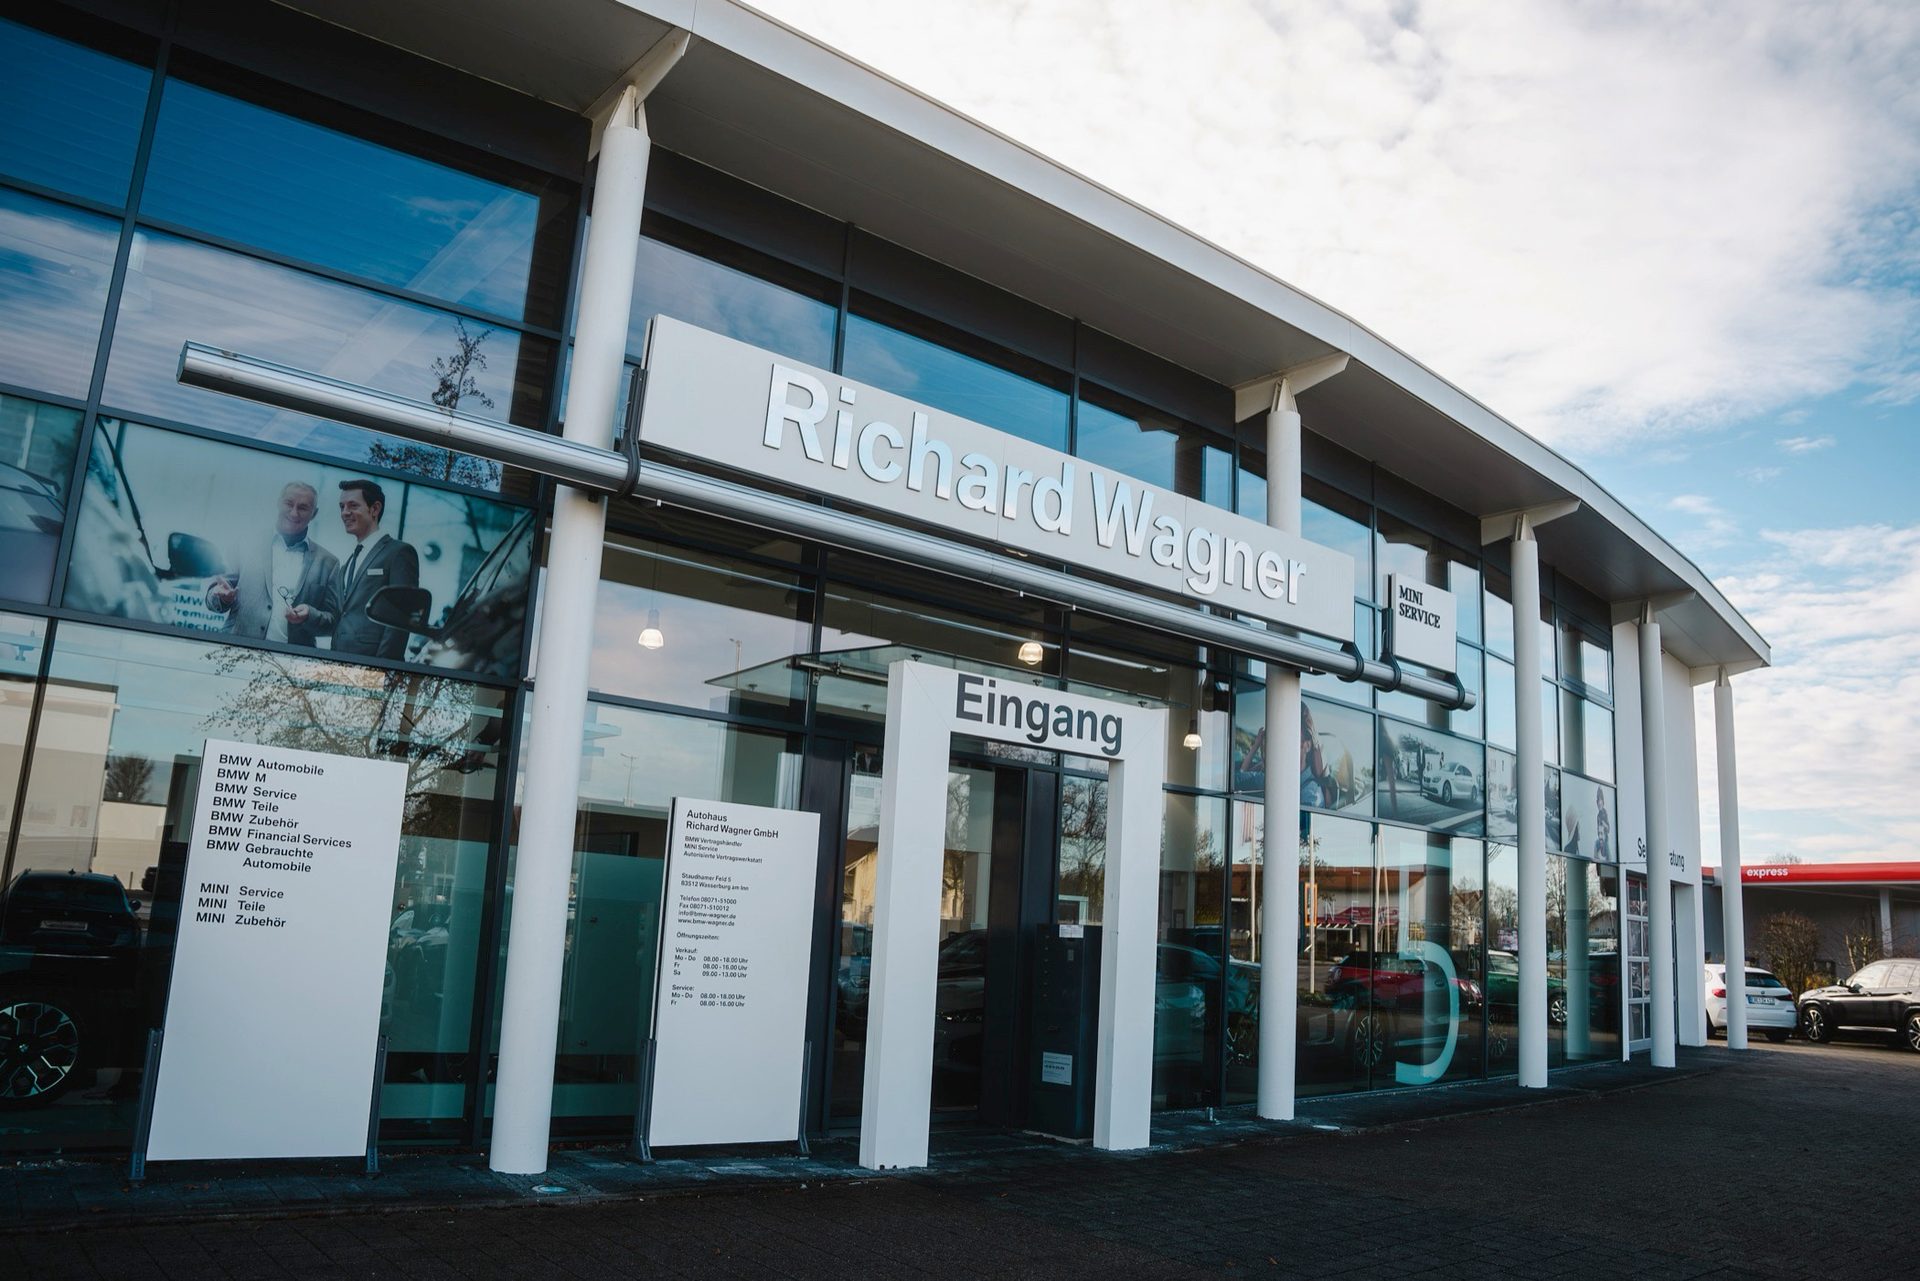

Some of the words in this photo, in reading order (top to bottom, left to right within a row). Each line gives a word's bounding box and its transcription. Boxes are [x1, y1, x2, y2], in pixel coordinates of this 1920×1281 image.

[762, 363, 1075, 536] Richard
[1091, 471, 1307, 604] Wagner
[1399, 585, 1423, 606] MINI
[174, 607, 225, 622] remium
[1399, 602, 1440, 629] SERVICE
[956, 673, 1122, 756] Eingang
[219, 754, 252, 767] BMW
[257, 758, 324, 776] Automobile
[217, 768, 250, 781] BMW
[255, 773, 267, 783] M
[215, 782, 248, 795] BMW
[253, 786, 297, 800] Service
[213, 796, 246, 809] BMW
[251, 800, 279, 813] Teile
[210, 811, 244, 823] BMW
[249, 814, 299, 829] Zubehör
[687, 809, 728, 822] Autohaus
[208, 825, 242, 837] BMW
[247, 829, 300, 844] Financial
[303, 834, 352, 848] Services
[686, 820, 719, 832] Richard
[720, 824, 752, 836] Wagner
[753, 828, 779, 838] GmbH
[206, 839, 240, 852] BMW
[245, 843, 314, 859] Gebrauchte
[698, 844, 718, 852] Service
[242, 857, 312, 872] Automobile
[1746, 868, 1789, 879] express
[200, 882, 229, 895] MINI
[239, 885, 284, 899] Service
[198, 897, 227, 909] MINI
[238, 900, 266, 912] Teile
[196, 911, 225, 924] MINI
[235, 914, 287, 928] Zubehör
